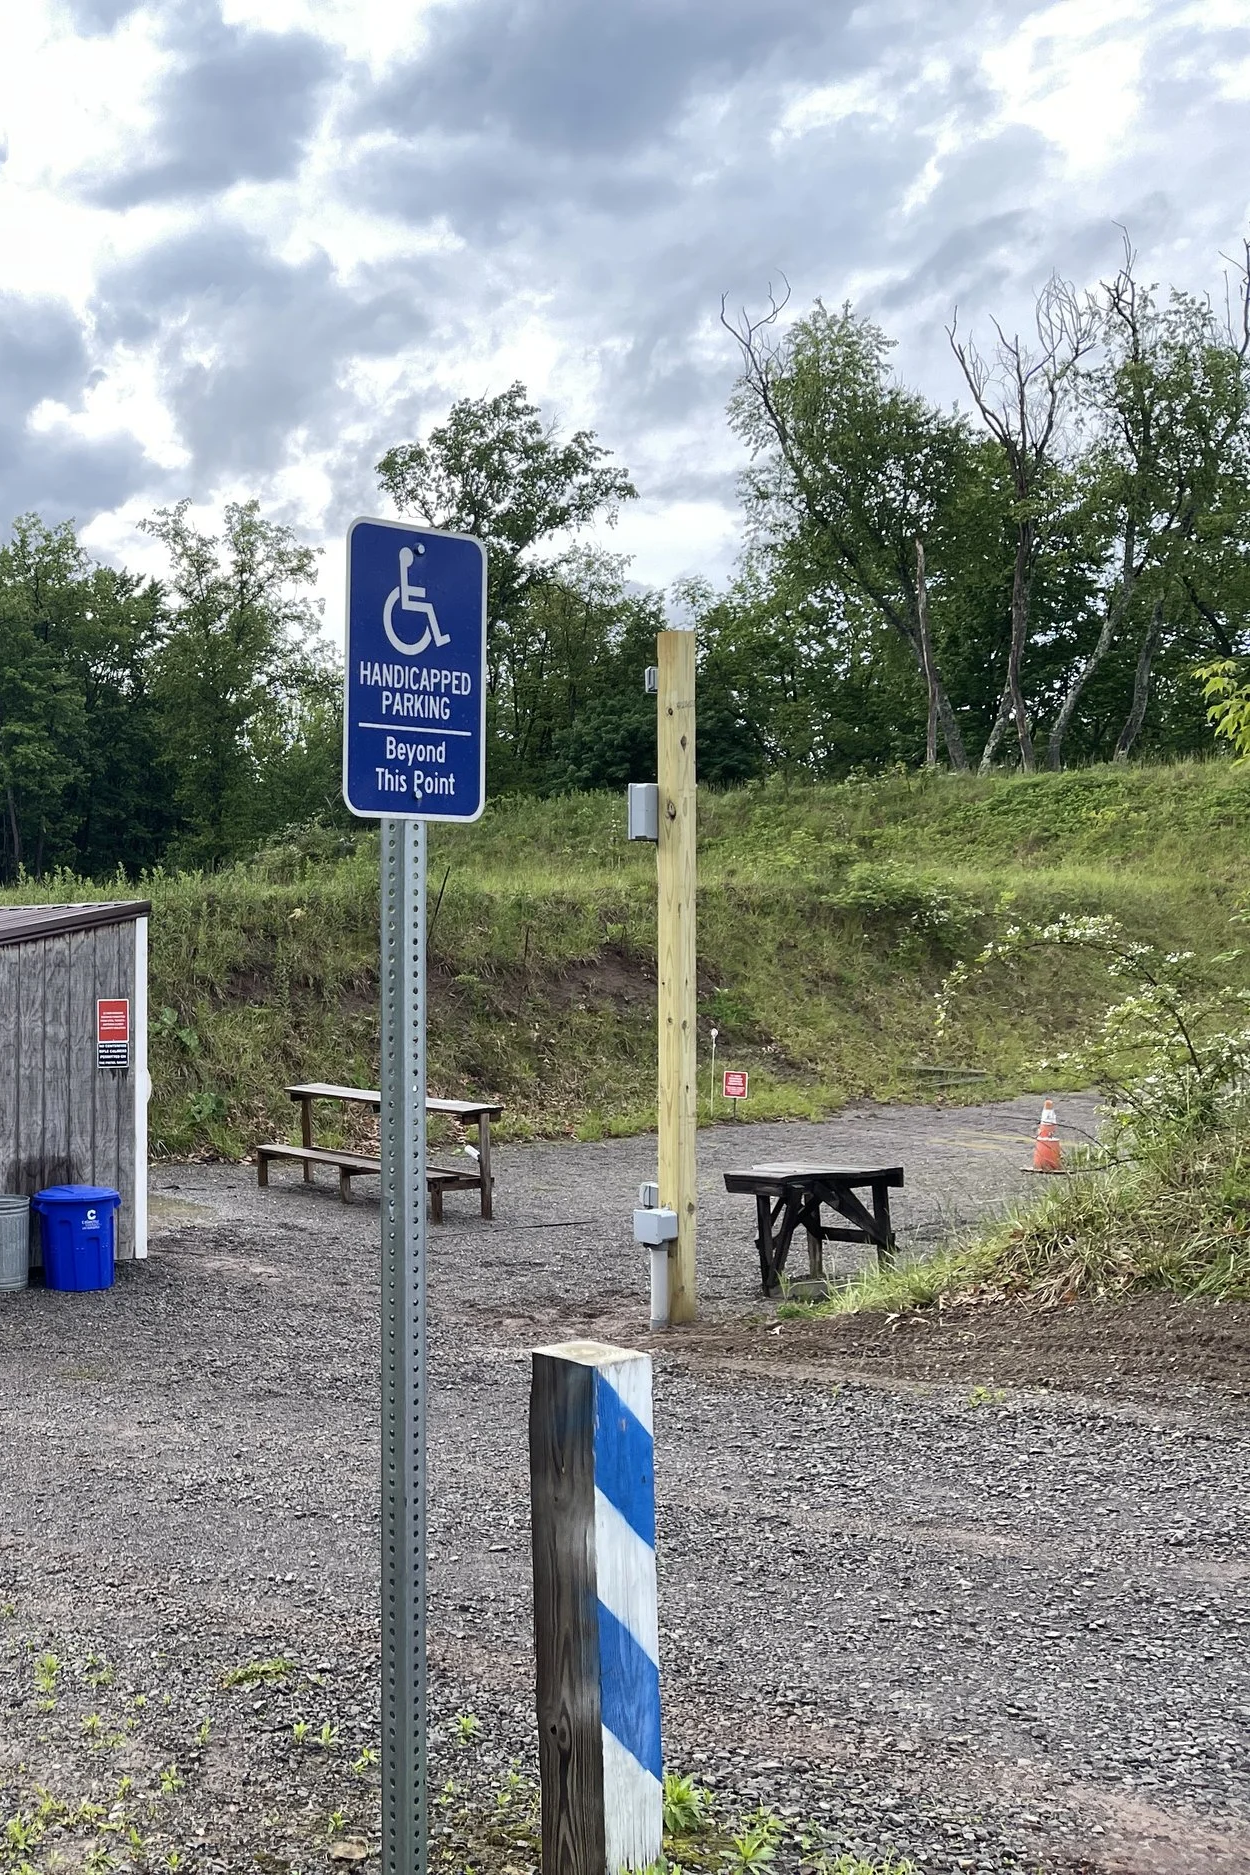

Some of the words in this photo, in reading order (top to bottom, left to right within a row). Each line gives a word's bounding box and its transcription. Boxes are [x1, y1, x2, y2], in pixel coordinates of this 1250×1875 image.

[360, 661, 471, 696] HANDICAPPED
[382, 691, 450, 721] PARKING
[386, 736, 446, 766] Beyond
[376, 768, 407, 792] This
[414, 770, 455, 795] Point
[87, 1209, 96, 1220] C
